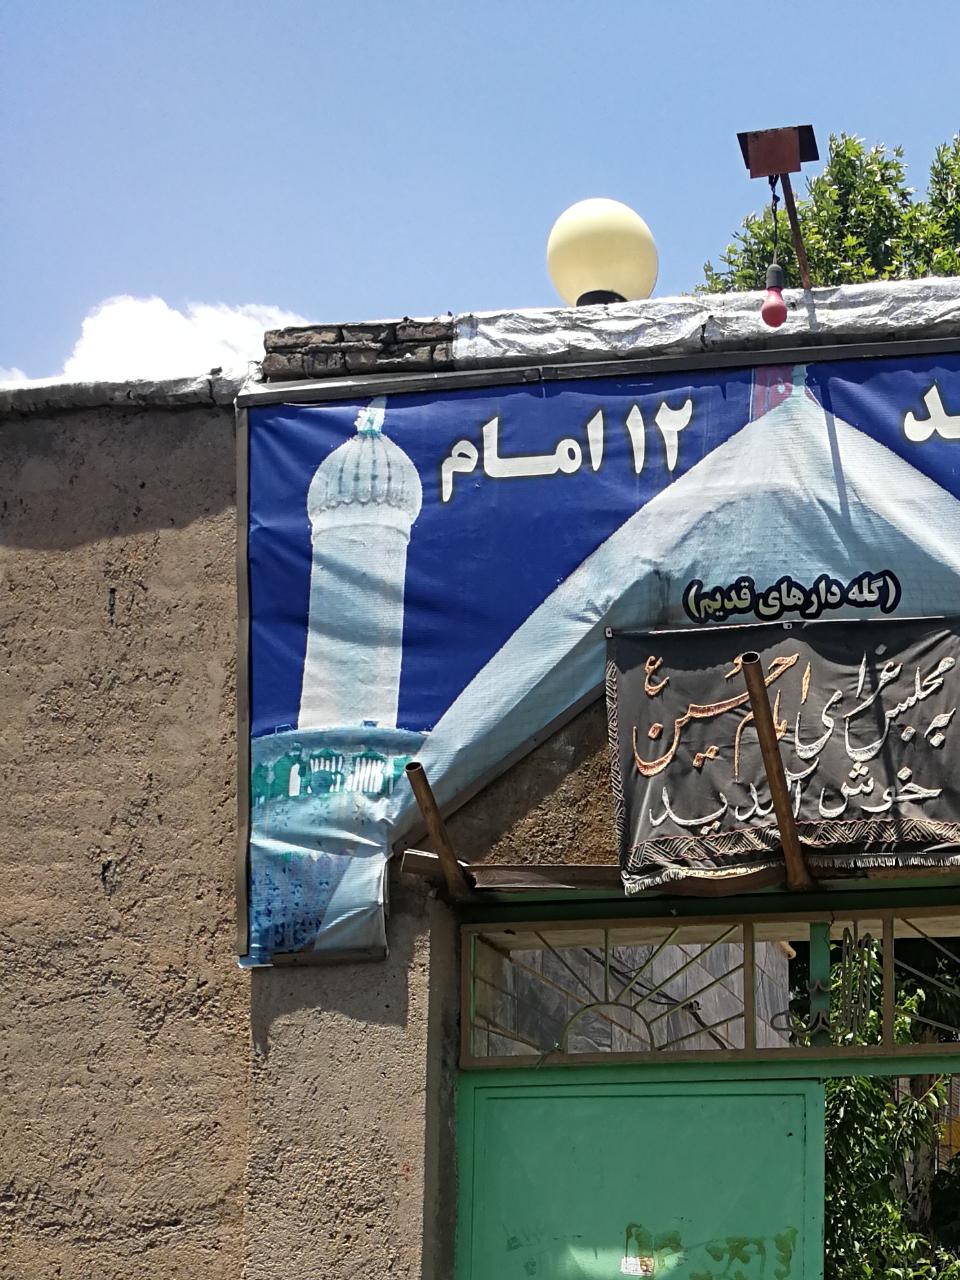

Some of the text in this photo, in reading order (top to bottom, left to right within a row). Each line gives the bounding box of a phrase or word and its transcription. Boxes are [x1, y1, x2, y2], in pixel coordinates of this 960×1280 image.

[441, 409, 604, 504] امام
[794, 643, 903, 760] عزای
[843, 656, 956, 763] مجلس
[649, 756, 943, 836] خوش آدید
